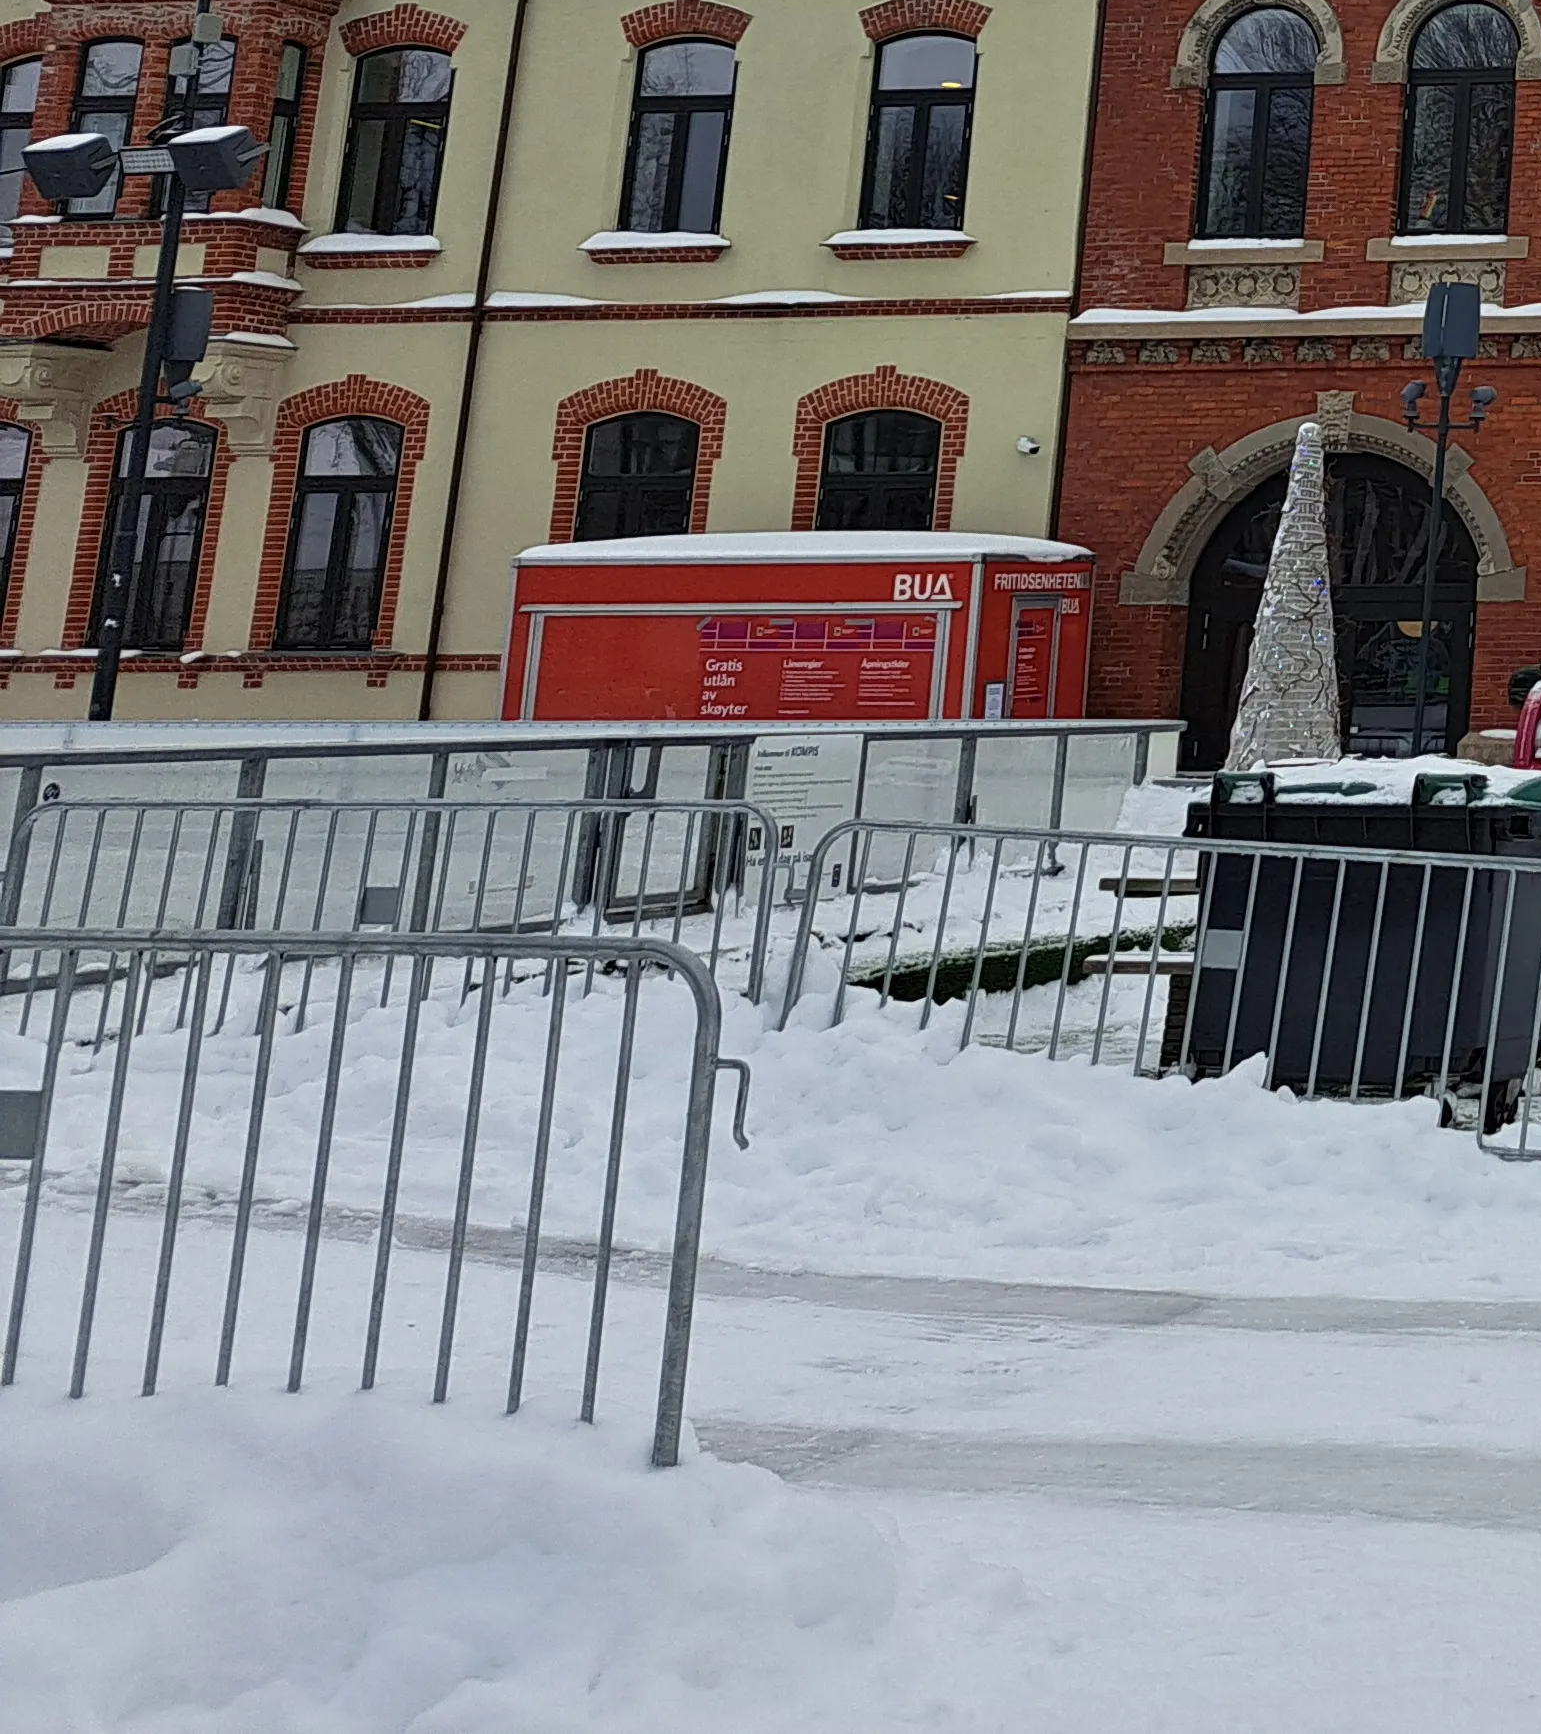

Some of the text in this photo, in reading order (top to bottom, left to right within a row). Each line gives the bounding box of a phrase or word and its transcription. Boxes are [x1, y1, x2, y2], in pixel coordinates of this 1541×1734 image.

[893, 573, 953, 601] BUA
[705, 658, 743, 672] Gratis
[703, 674, 736, 687] utlån
[701, 690, 717, 701] av
[700, 703, 749, 718] skøyter
